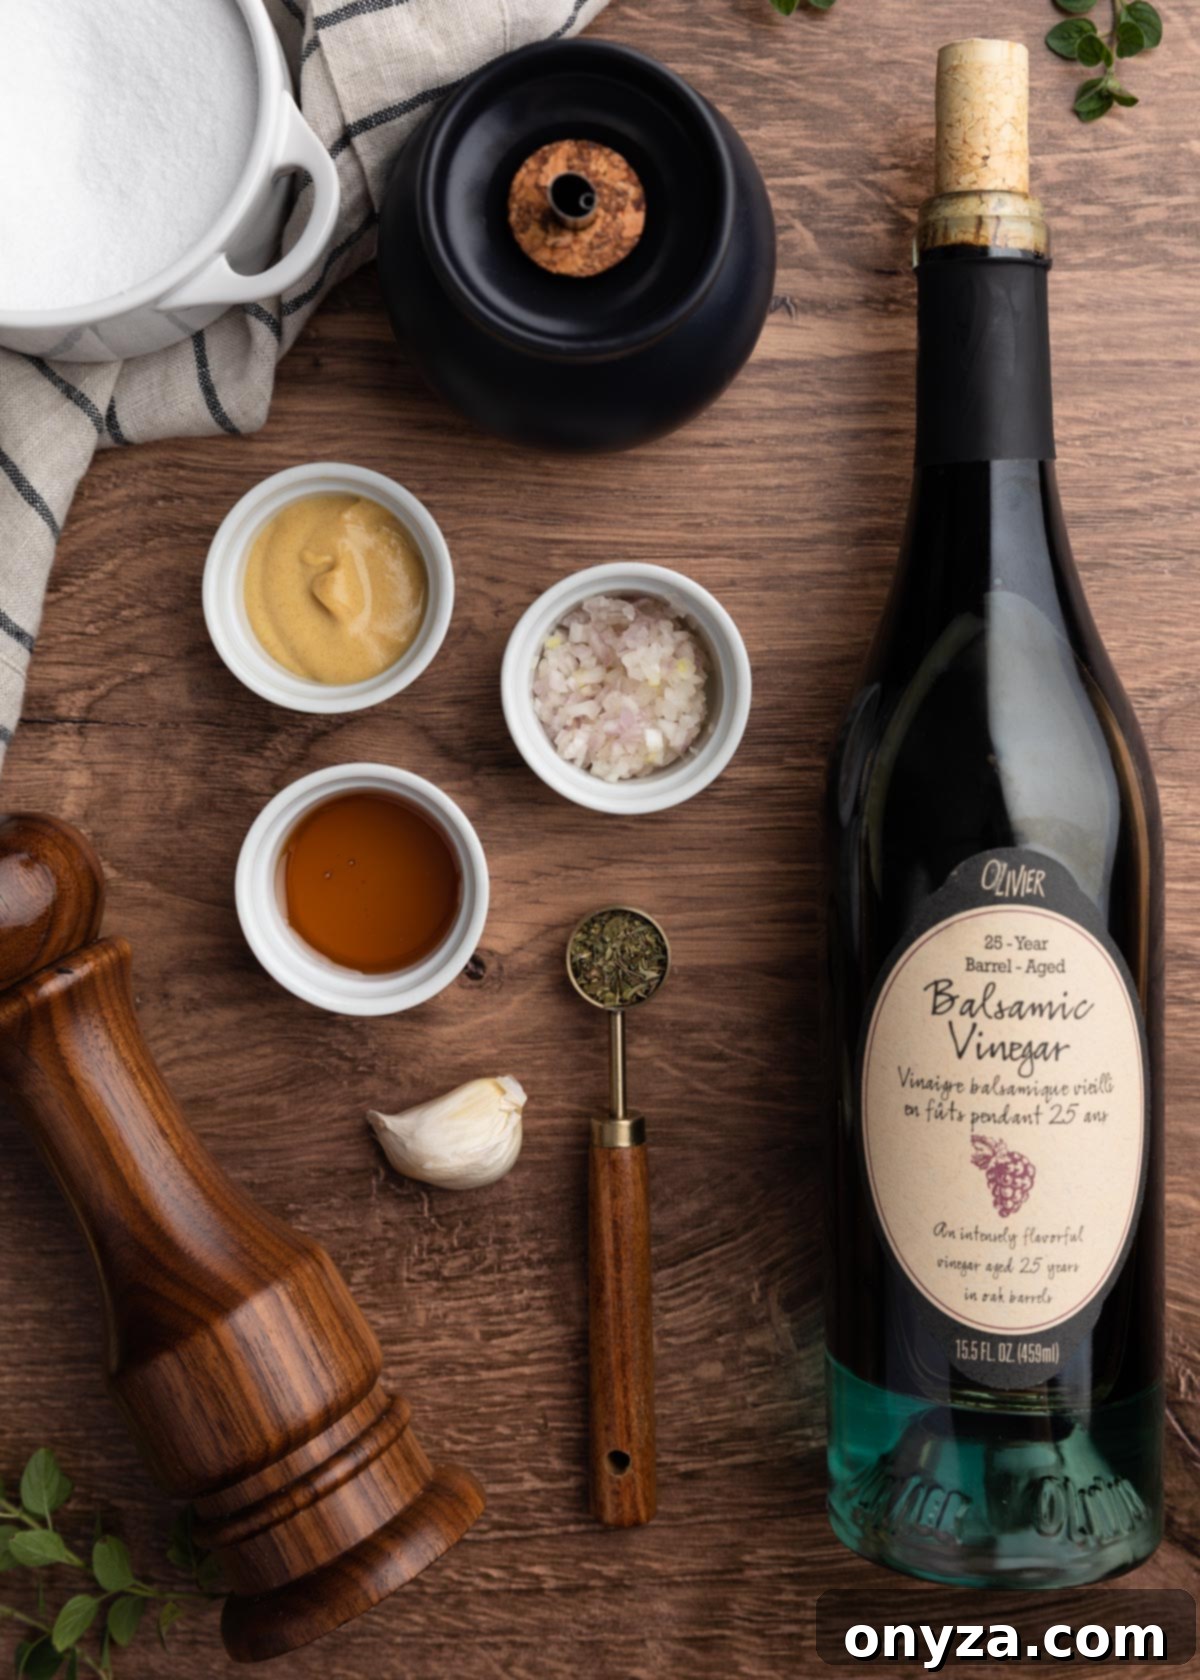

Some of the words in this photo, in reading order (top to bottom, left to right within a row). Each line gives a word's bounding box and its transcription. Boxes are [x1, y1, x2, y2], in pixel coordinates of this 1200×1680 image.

[981, 859, 1047, 898] OLIVIER
[984, 934, 1003, 950] 25
[1014, 936, 1049, 951] Year
[965, 957, 1012, 974] Barrel
[1025, 959, 1066, 977] Aged
[923, 978, 1095, 1021] Balsamic
[948, 1020, 1071, 1078] Vinegar
[897, 1065, 965, 1101] Vinaigre
[969, 1074, 1070, 1104] balsamique
[970, 1103, 1043, 1133] pendant
[1048, 1102, 1080, 1126] 25
[1083, 1110, 1109, 1124] ans
[932, 1221, 957, 1241] An
[959, 1225, 1017, 1250] intensely
[1022, 1225, 1085, 1247] flavorful
[936, 1256, 981, 1278] vinegar
[985, 1257, 1013, 1280] aged
[1018, 1257, 1044, 1275] 25
[1047, 1263, 1080, 1281] years
[964, 1287, 978, 1302] in
[981, 1286, 1006, 1304] oak
[1008, 1287, 1053, 1305] barrels
[955, 1339, 979, 1361] 15.5
[1016, 1341, 1060, 1366] (459ml)
